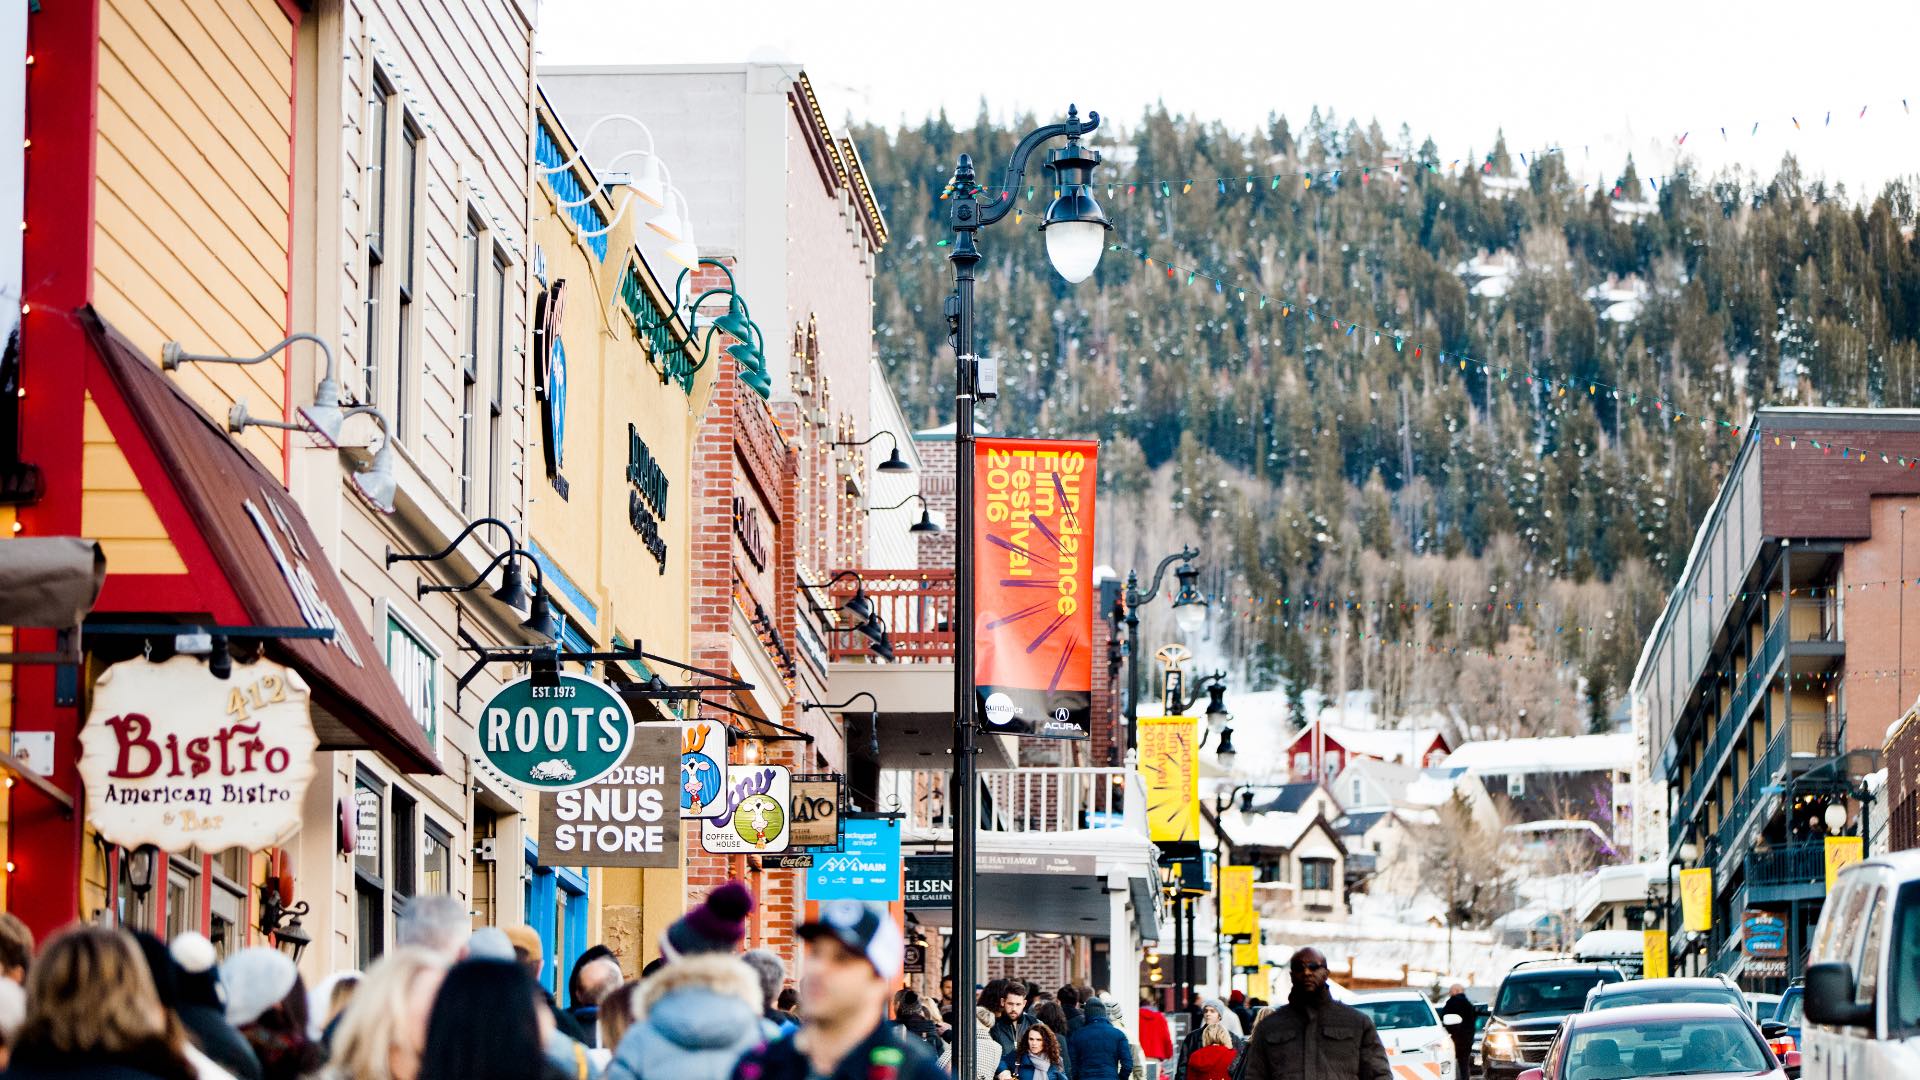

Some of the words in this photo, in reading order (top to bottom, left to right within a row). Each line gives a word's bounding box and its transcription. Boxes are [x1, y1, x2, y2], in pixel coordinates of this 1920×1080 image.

[986, 448, 1010, 523] 2016
[1035, 451, 1061, 517] Film
[1009, 450, 1036, 576] Festival
[1057, 450, 1085, 616] Sundance
[226, 674, 286, 721] 412
[553, 686, 576, 698] 1973
[487, 706, 621, 753] ROOTS
[1044, 722, 1082, 731] ACURA
[105, 713, 291, 779] Bistro
[596, 766, 664, 785] DISH
[1181, 721, 1192, 803] Sundance
[105, 784, 212, 805] American
[222, 783, 291, 804] Bistro
[556, 788, 664, 822] SNUS
[180, 810, 224, 832] Bar
[555, 824, 664, 853] STORE
[705, 833, 734, 841] COFFEE
[860, 863, 887, 872] MAIN
[988, 856, 1038, 865] HATHAWAY
[905, 879, 953, 893] ELSEN
